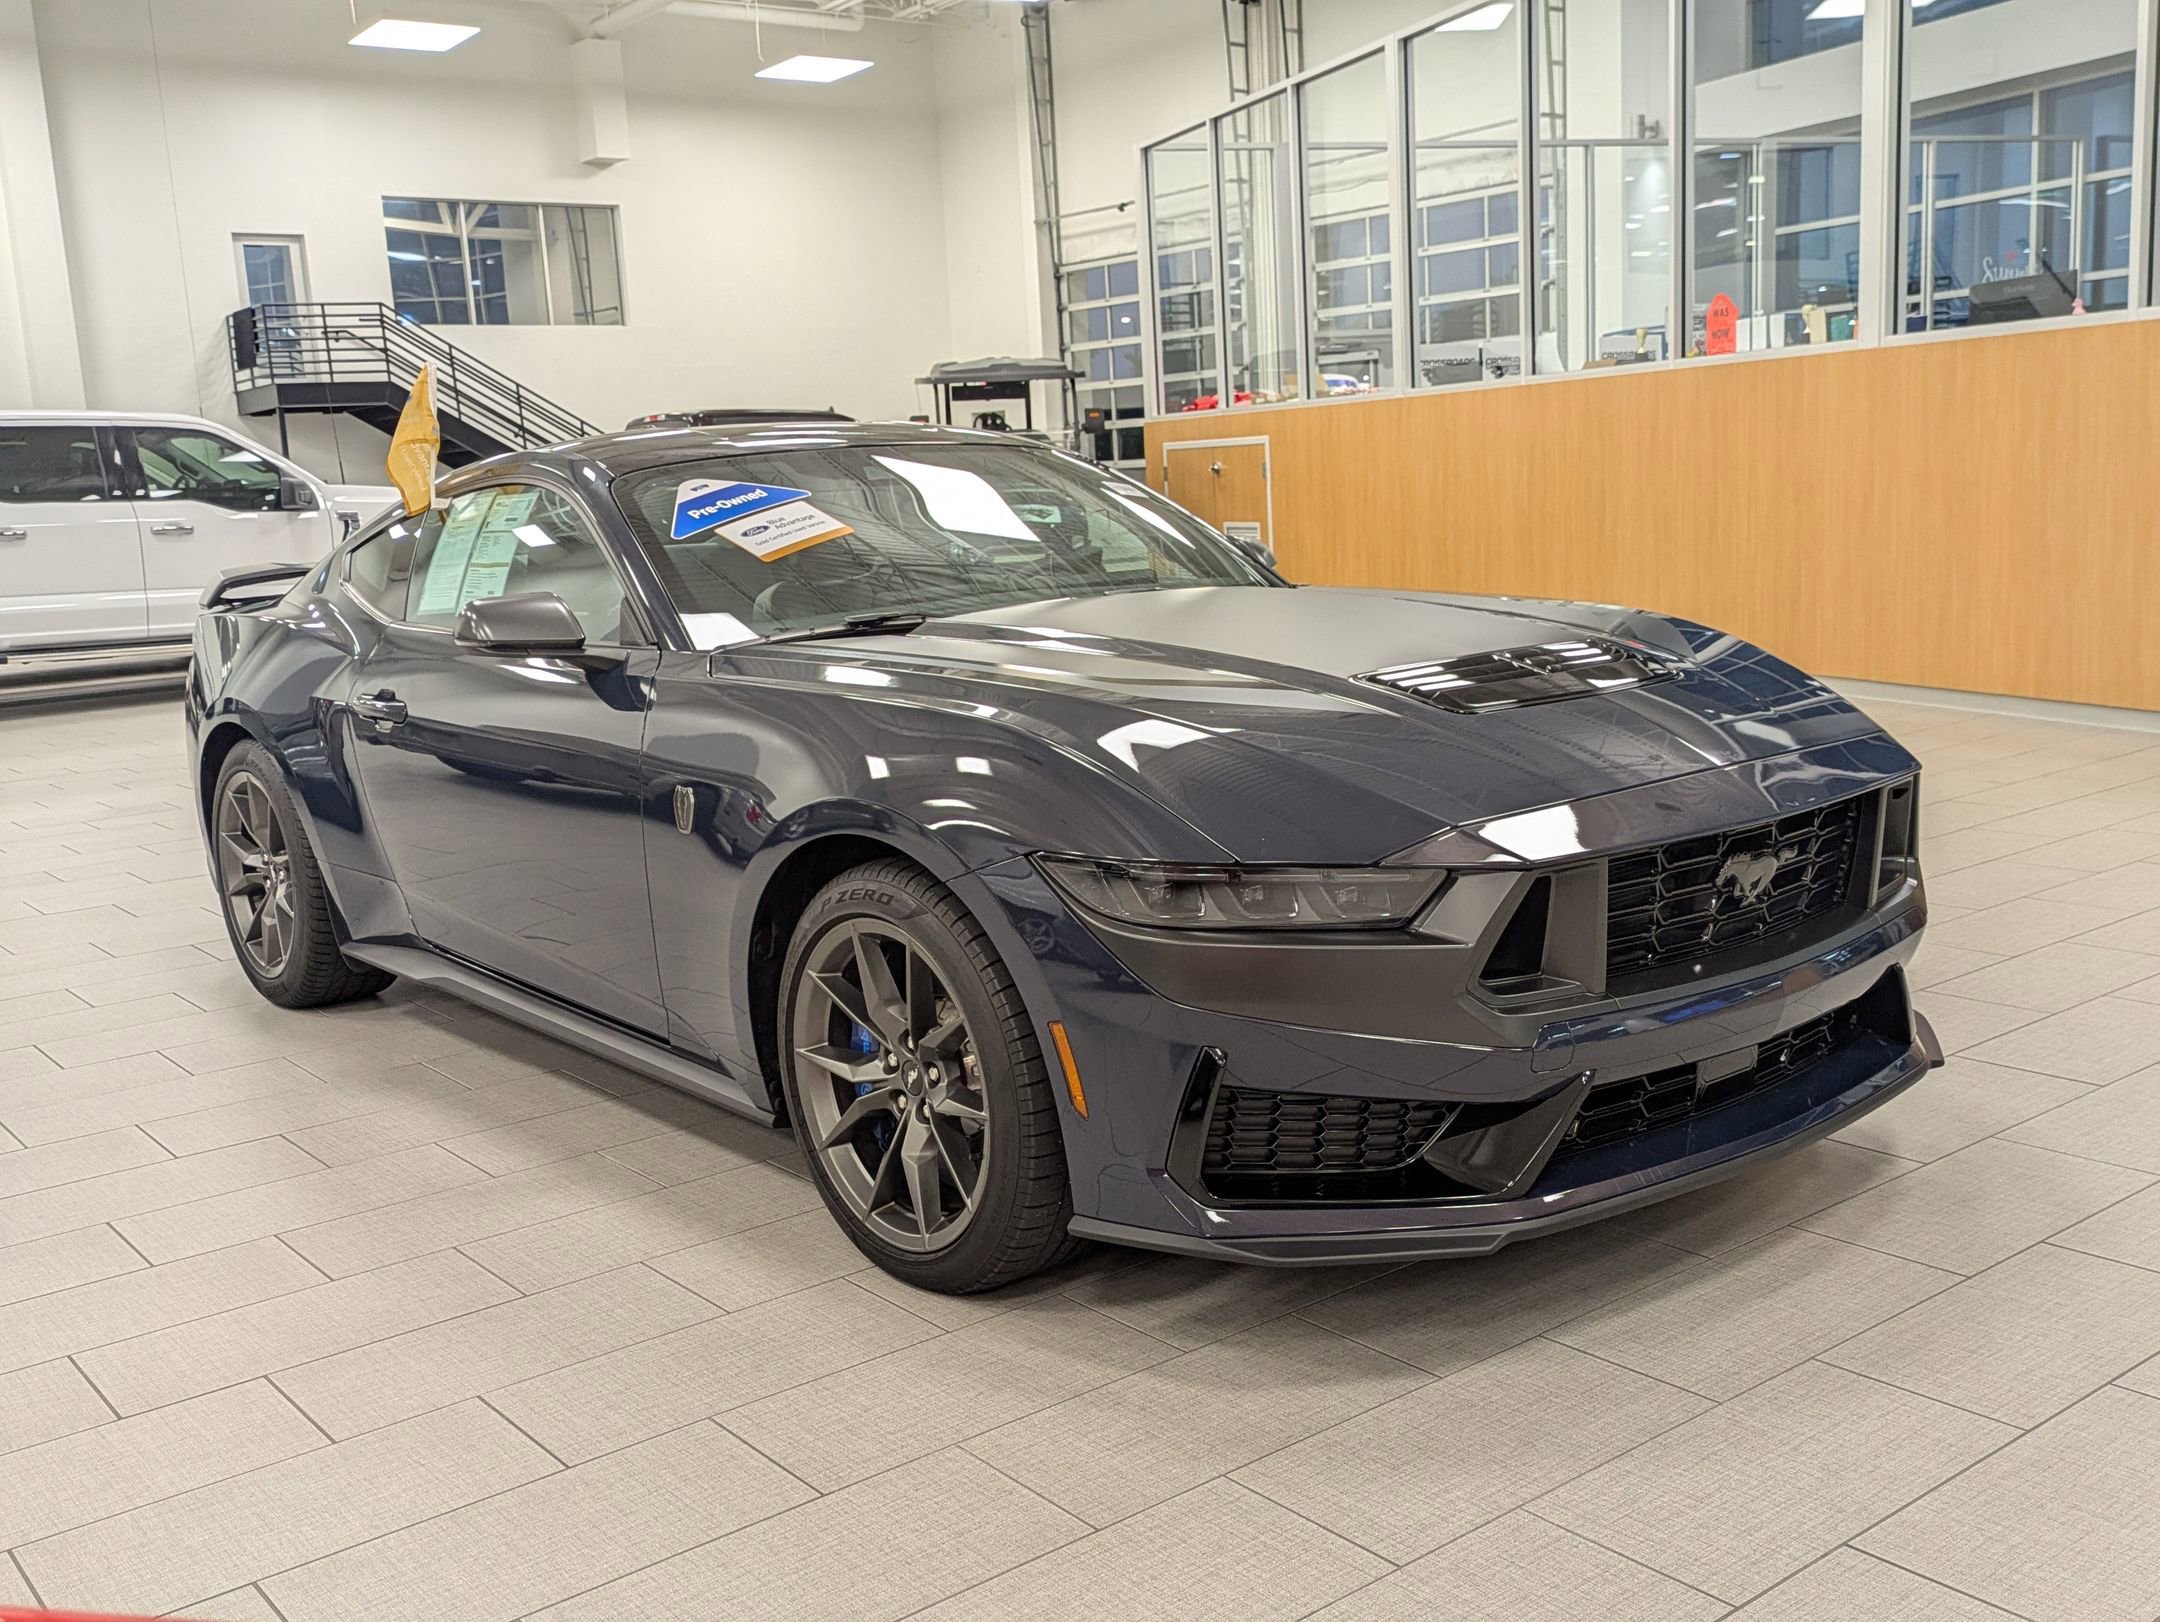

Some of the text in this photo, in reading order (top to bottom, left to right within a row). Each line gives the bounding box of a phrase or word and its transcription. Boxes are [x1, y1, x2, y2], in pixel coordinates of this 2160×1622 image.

[1713, 307, 1729, 318] WAS
[1711, 328, 1730, 339] NOW
[687, 488, 769, 519] Pre-Owned
[820, 888, 894, 913] P ZERO
